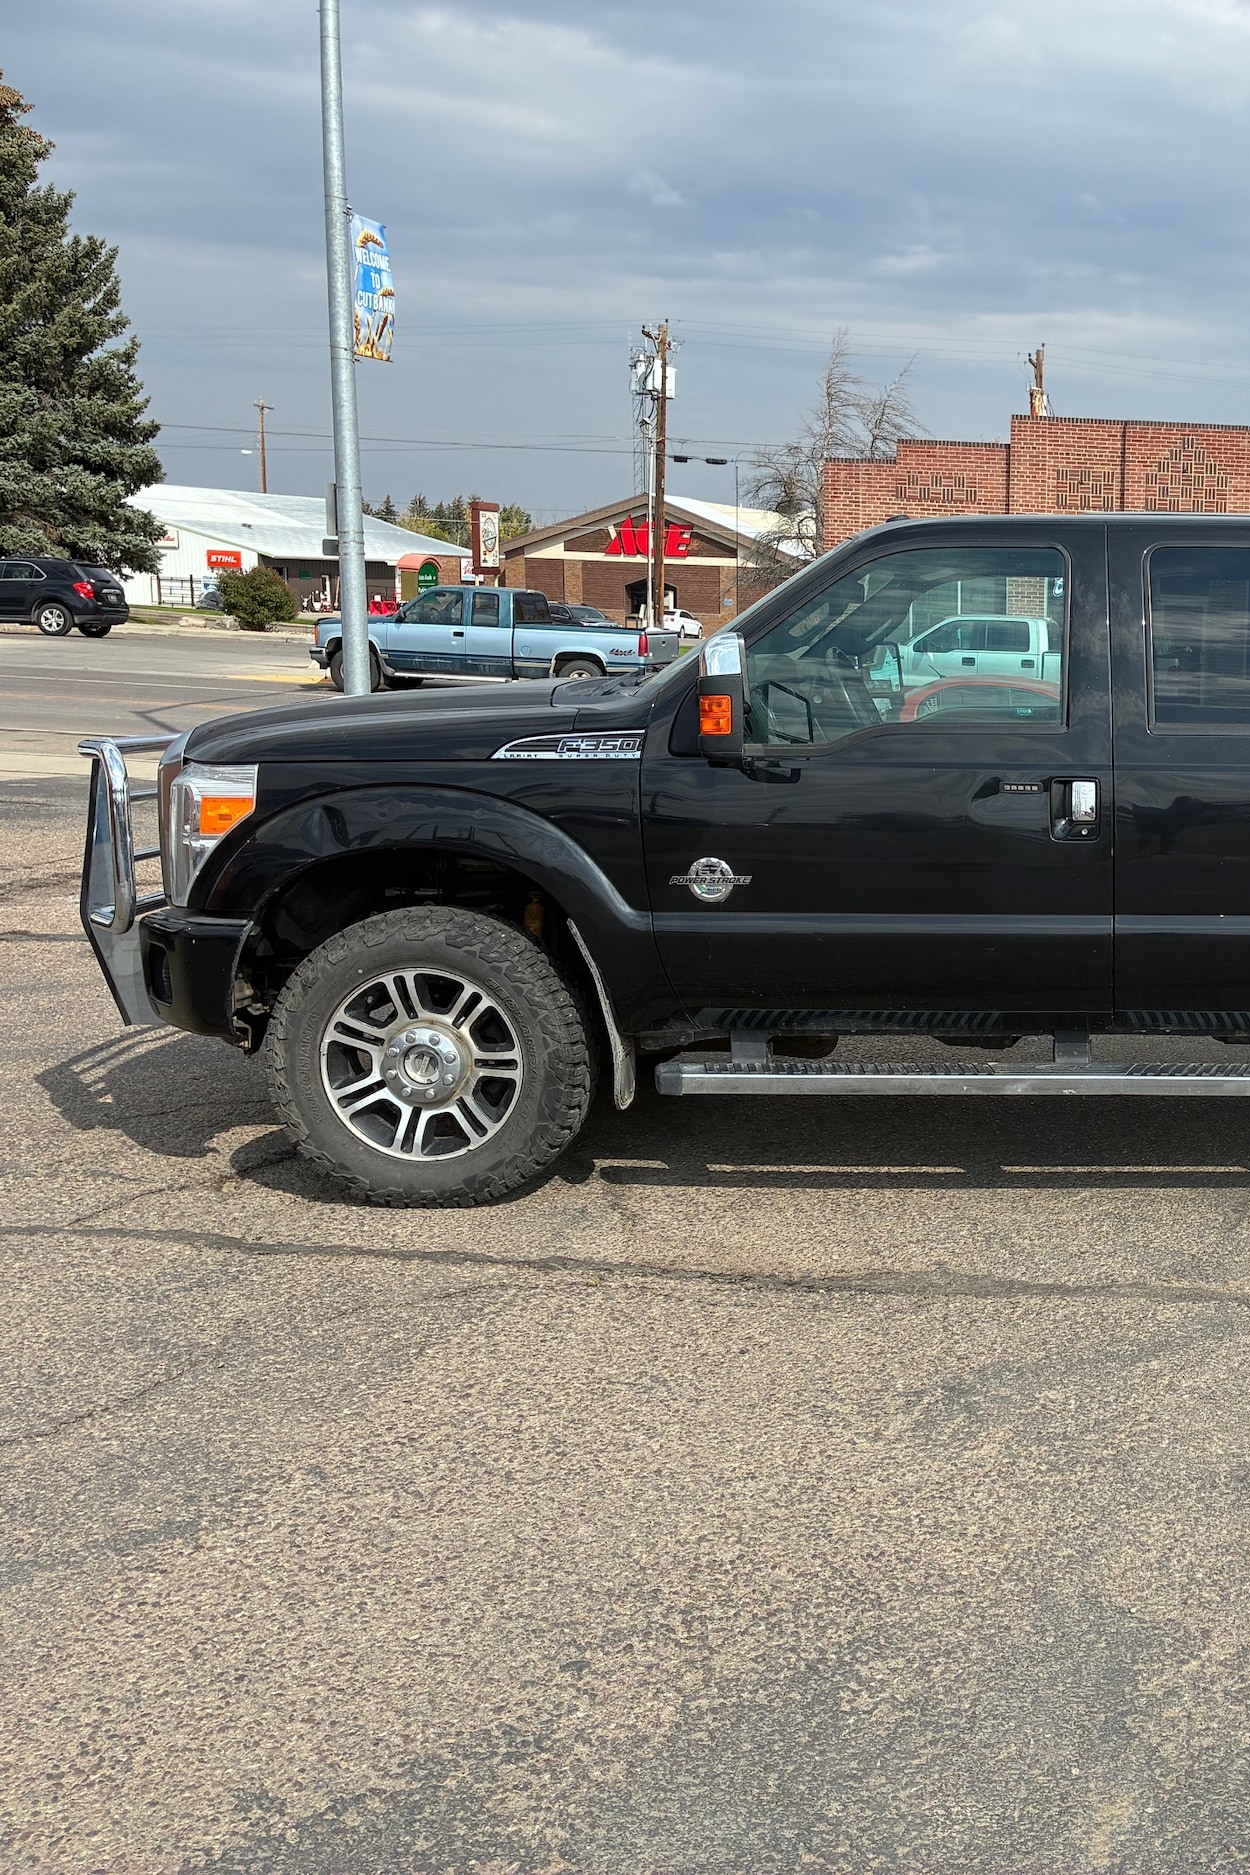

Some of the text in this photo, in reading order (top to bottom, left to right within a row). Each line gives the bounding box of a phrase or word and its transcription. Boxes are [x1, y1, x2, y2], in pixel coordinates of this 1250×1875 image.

[355, 247, 391, 272] WELCOME
[370, 272, 381, 290] TO
[210, 554, 237, 563] STIHL
[669, 876, 752, 884] POWER STROKE
[484, 977, 538, 1096] GEOLANDAR
[299, 1012, 325, 1124] YOKOHAMA
